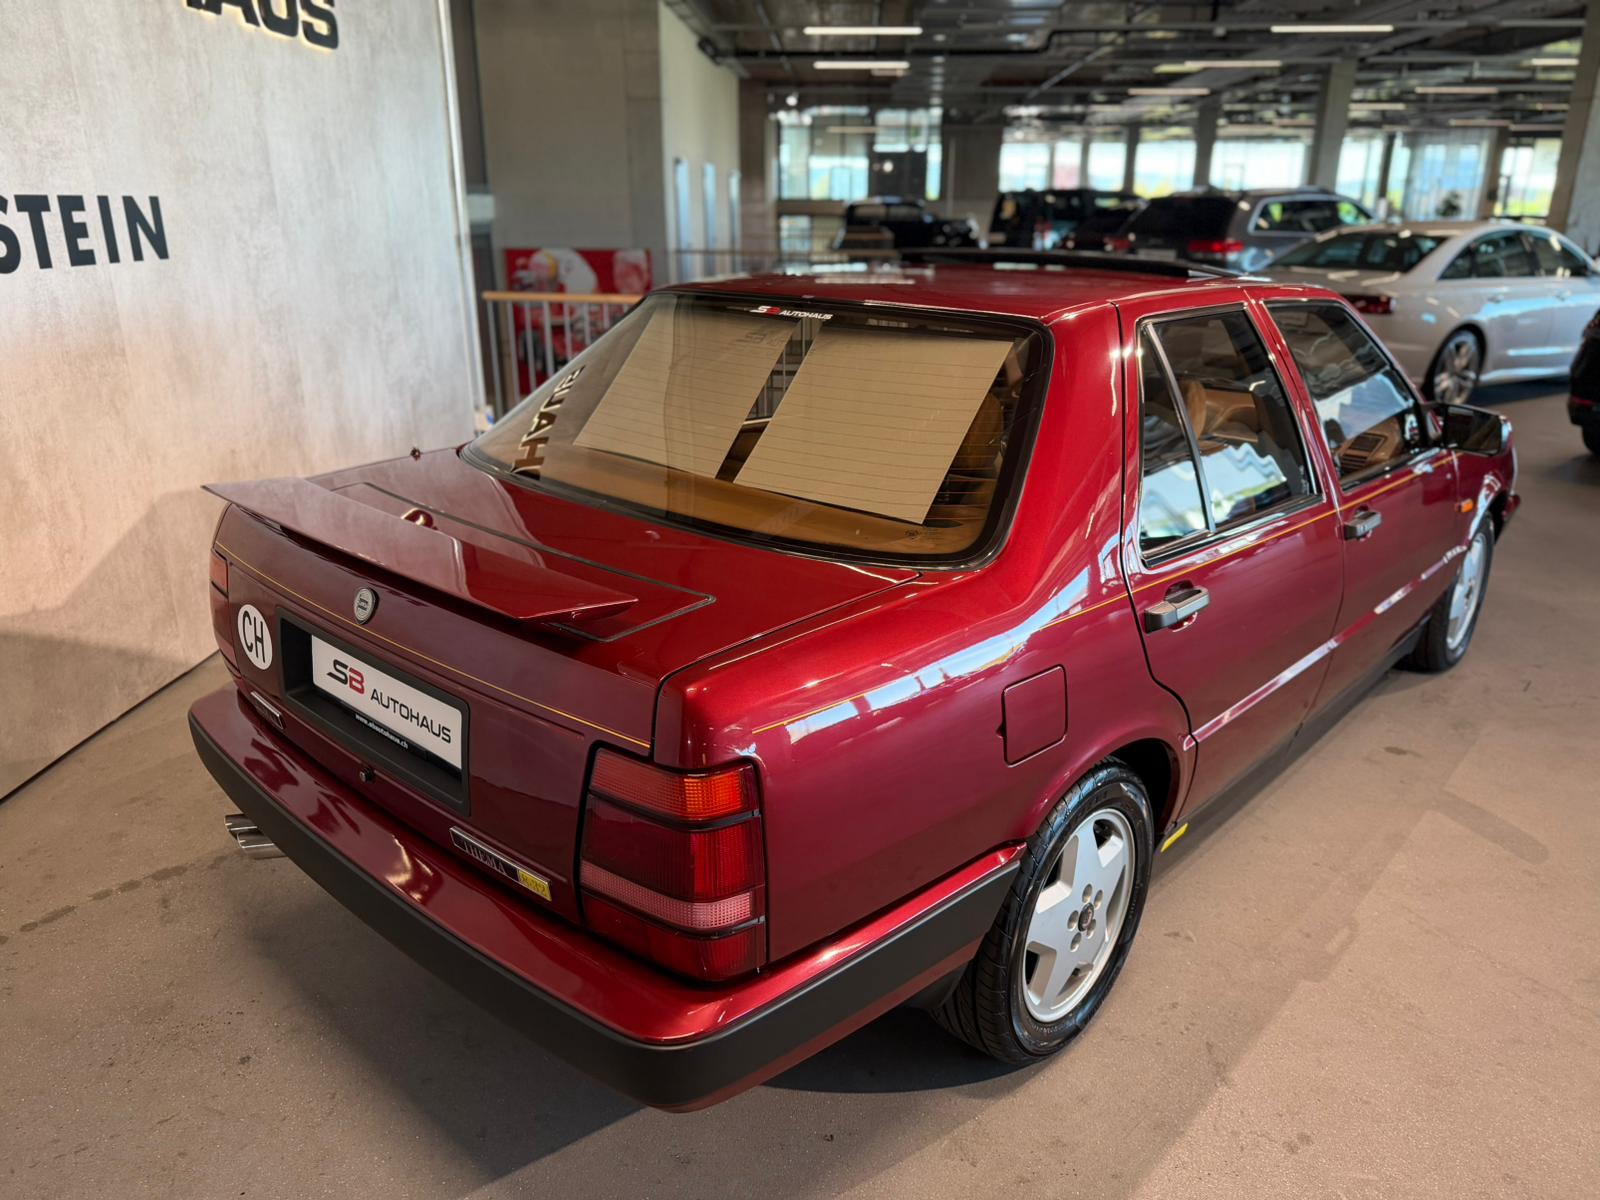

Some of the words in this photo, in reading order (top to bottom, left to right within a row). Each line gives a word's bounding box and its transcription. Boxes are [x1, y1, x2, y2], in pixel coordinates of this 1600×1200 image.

[187, 0, 339, 50] US
[778, 309, 834, 320] AUTOHAUS
[242, 610, 266, 664] CH
[326, 659, 365, 695] SB
[370, 688, 452, 744] AUTOHAUS
